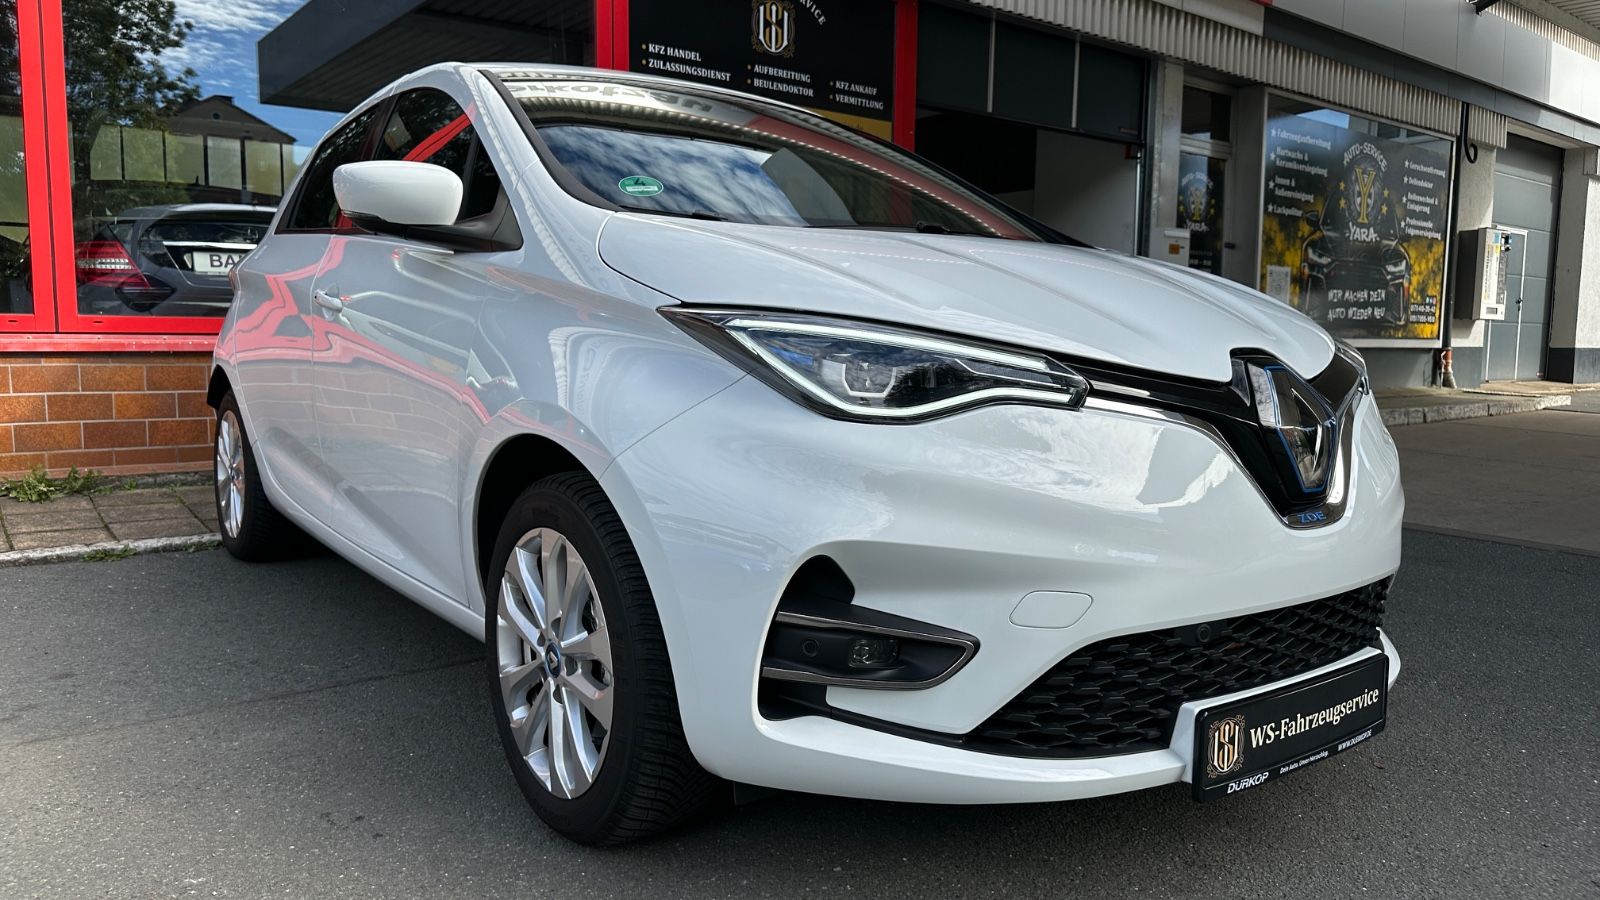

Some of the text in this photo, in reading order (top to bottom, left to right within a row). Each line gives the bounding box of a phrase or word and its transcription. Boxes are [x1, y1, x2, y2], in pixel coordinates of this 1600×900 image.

[800, 0, 826, 25] VICE
[649, 43, 701, 61] KFZ HANDEL
[649, 59, 731, 81] ZULASSUNGSDIENST
[754, 64, 811, 83] AUFBEREITUNG
[754, 78, 814, 97] BEULENDOKTOR
[836, 80, 877, 95] KFZ ANKAUF
[836, 94, 883, 110] VERMITTLUNG
[1344, 142, 1387, 171] AUTO-SERVICE
[209, 254, 242, 268] BA
[1328, 289, 1385, 303] WIR MACHEN DEIN
[1328, 307, 1346, 321] AUTO
[1348, 306, 1372, 320] WIEDER
[1298, 511, 1326, 523] ZOE
[1250, 688, 1379, 749] WS-Fahrzeugservice
[1227, 772, 1269, 794] DÜRKOP
